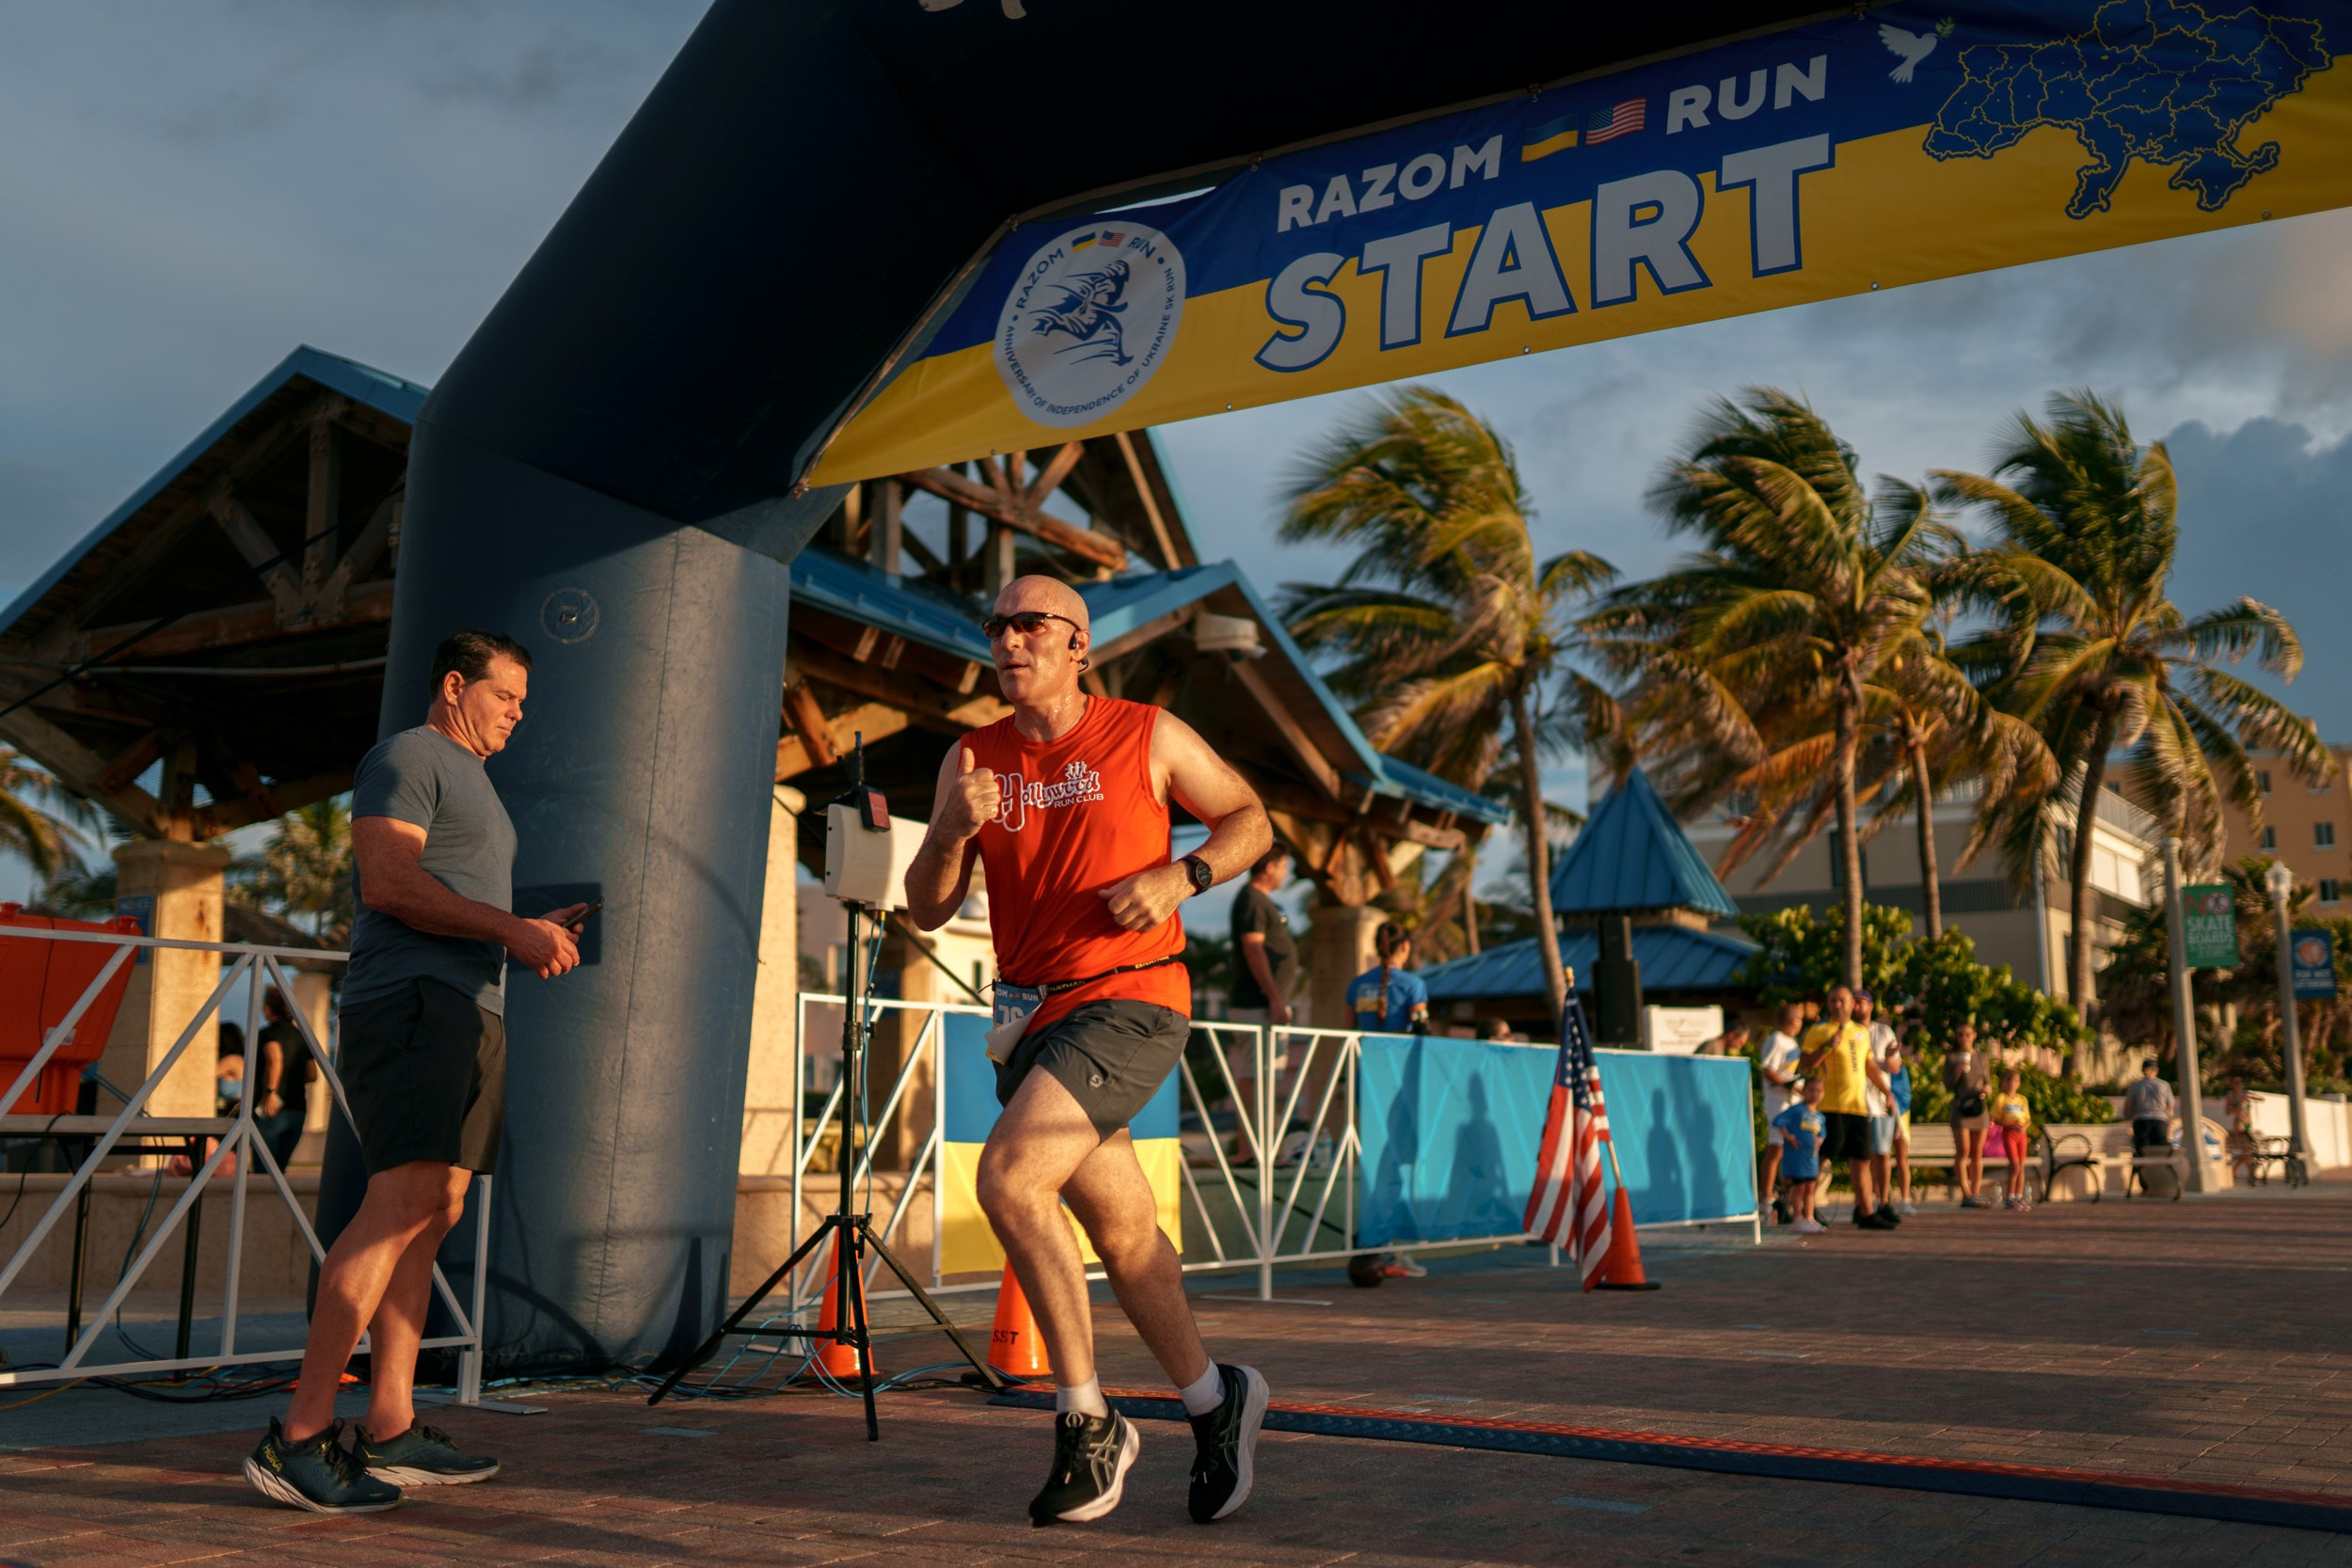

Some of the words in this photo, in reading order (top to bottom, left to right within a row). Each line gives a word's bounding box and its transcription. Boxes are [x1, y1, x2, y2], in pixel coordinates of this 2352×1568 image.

[1277, 135, 1503, 233] RAZOM
[1666, 54, 1828, 135] RUN
[1254, 133, 1836, 373] START
[1016, 248, 1064, 309] RAZOM
[1127, 236, 1156, 259] RUN
[1164, 267, 1174, 293] RUN
[1164, 294, 1174, 310] 5K
[1141, 313, 1170, 367] UKRAINE
[1005, 325, 1037, 399] ANNIVERSARY
[1126, 368, 1140, 385] OF
[1034, 397, 1047, 408] OF
[1046, 384, 1125, 415] INDEPENDENCE
[1054, 798, 1074, 808] RUN
[1076, 793, 1104, 803] CLUB
[1022, 993, 1039, 1002] RUN
[262, 1444, 283, 1472] HOKA
